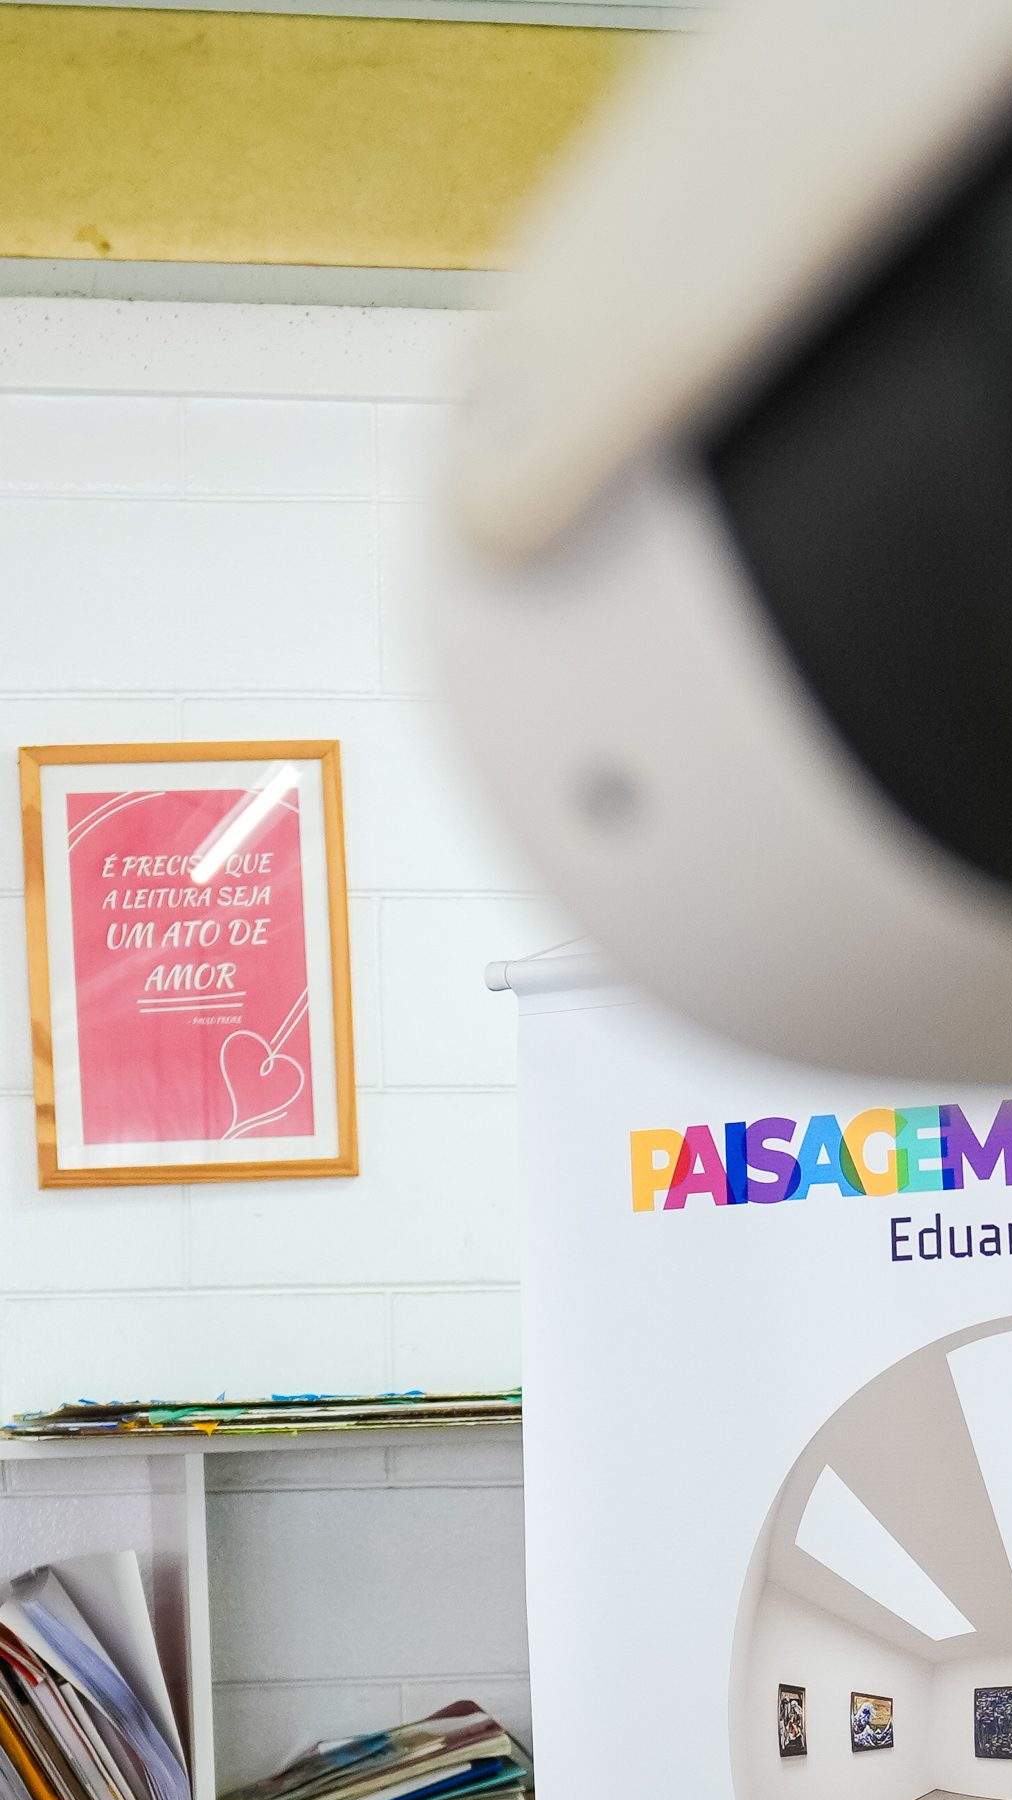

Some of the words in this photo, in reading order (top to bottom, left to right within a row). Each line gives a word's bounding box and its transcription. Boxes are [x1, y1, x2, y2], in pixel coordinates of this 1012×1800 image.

[101, 853, 117, 878] É
[122, 855, 206, 878] PRECIS
[224, 852, 274, 878] QUE
[102, 889, 118, 910] A
[122, 887, 212, 910] LEITURA
[217, 885, 272, 907] SEJA
[106, 921, 155, 950] UM
[161, 919, 221, 948] ATO
[228, 918, 272, 945] DE
[144, 962, 237, 992] AMOR
